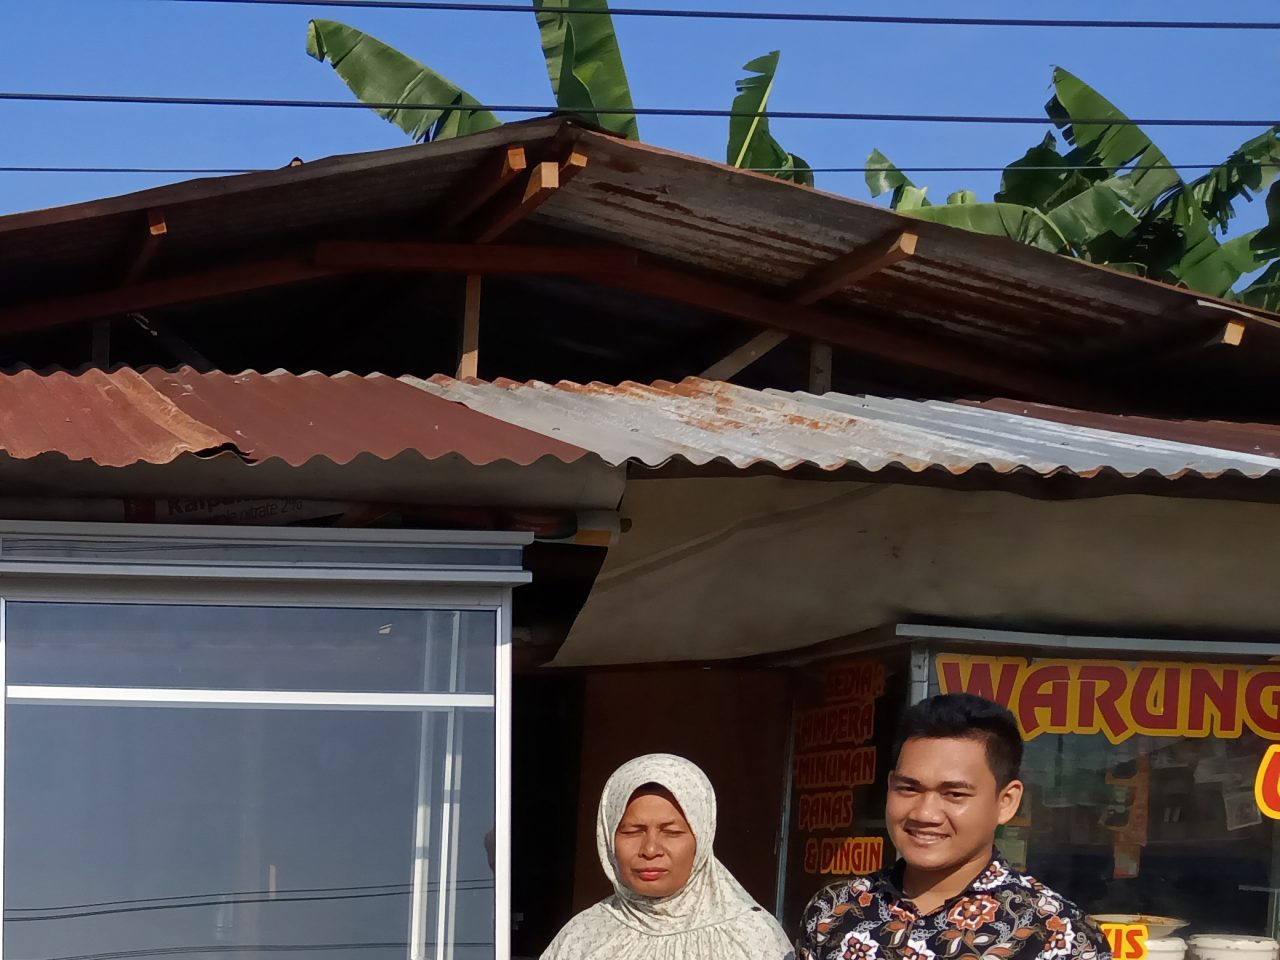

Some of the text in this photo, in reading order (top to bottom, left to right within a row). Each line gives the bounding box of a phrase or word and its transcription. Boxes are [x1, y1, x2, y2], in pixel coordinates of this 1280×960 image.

[797, 750, 875, 785] MINUMAN
[800, 794, 852, 827] PANAS
[806, 838, 882, 872] & DINGIN
